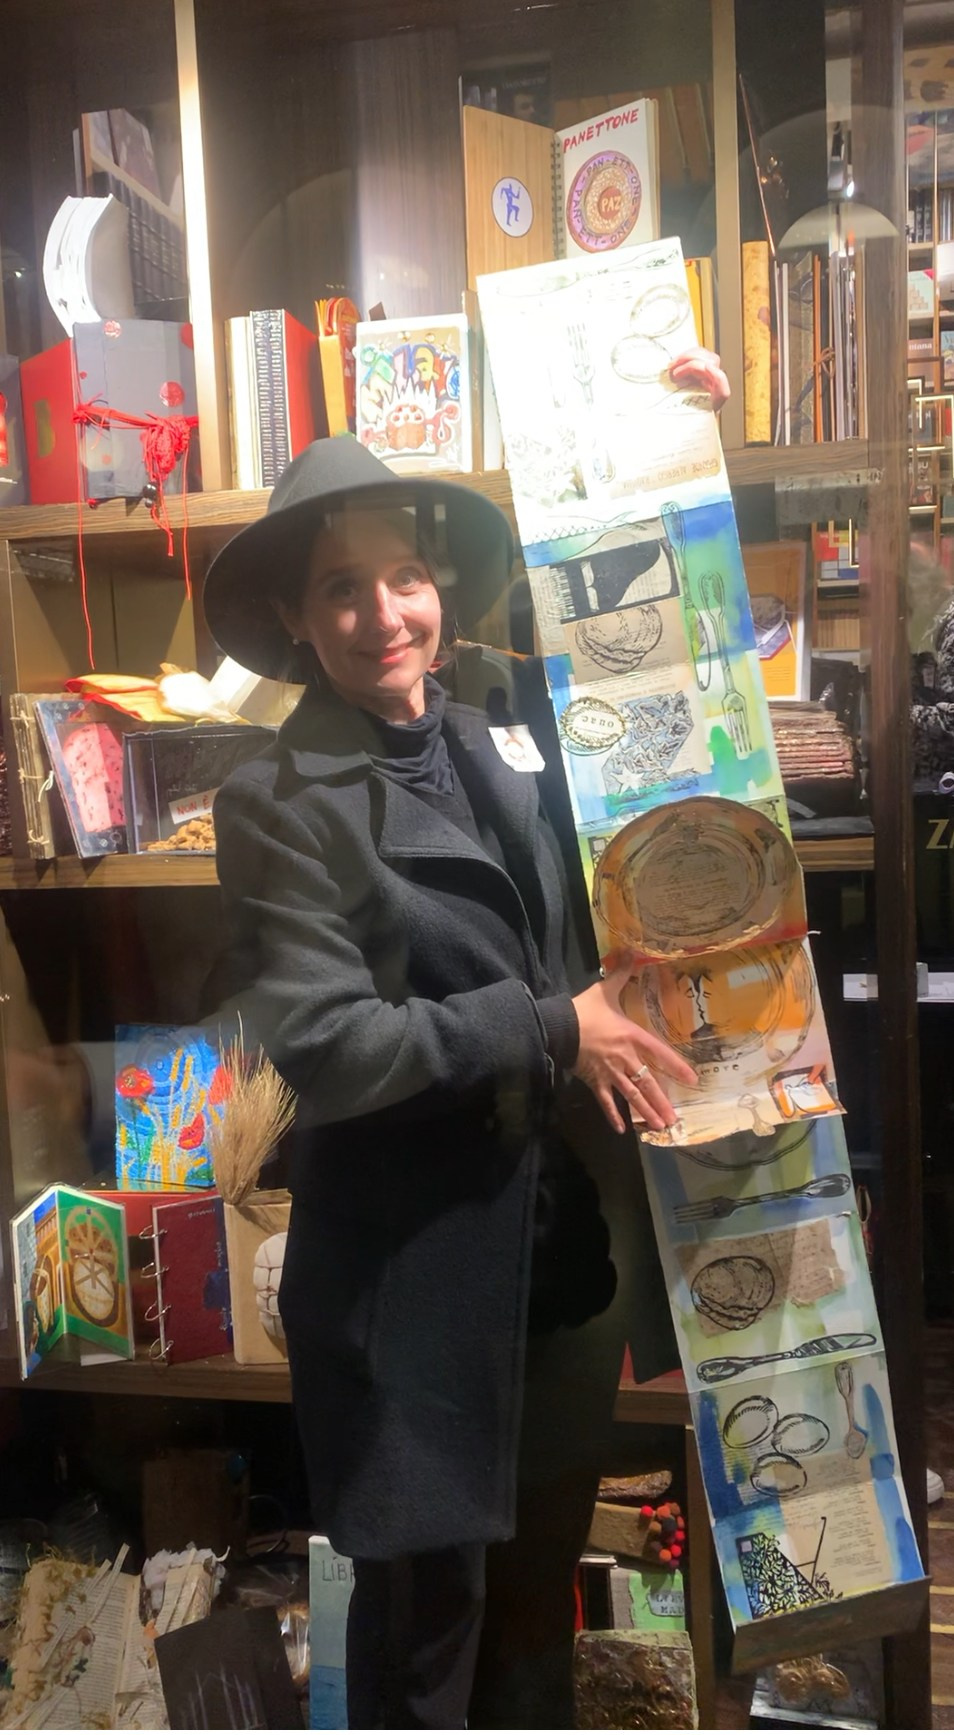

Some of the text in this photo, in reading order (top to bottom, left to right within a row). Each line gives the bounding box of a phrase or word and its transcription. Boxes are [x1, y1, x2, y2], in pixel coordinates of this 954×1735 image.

[563, 108, 639, 153] PANETTONE
[600, 196, 622, 213] PAZ
[176, 800, 198, 816] NON
[926, 818, 954, 849] Z
